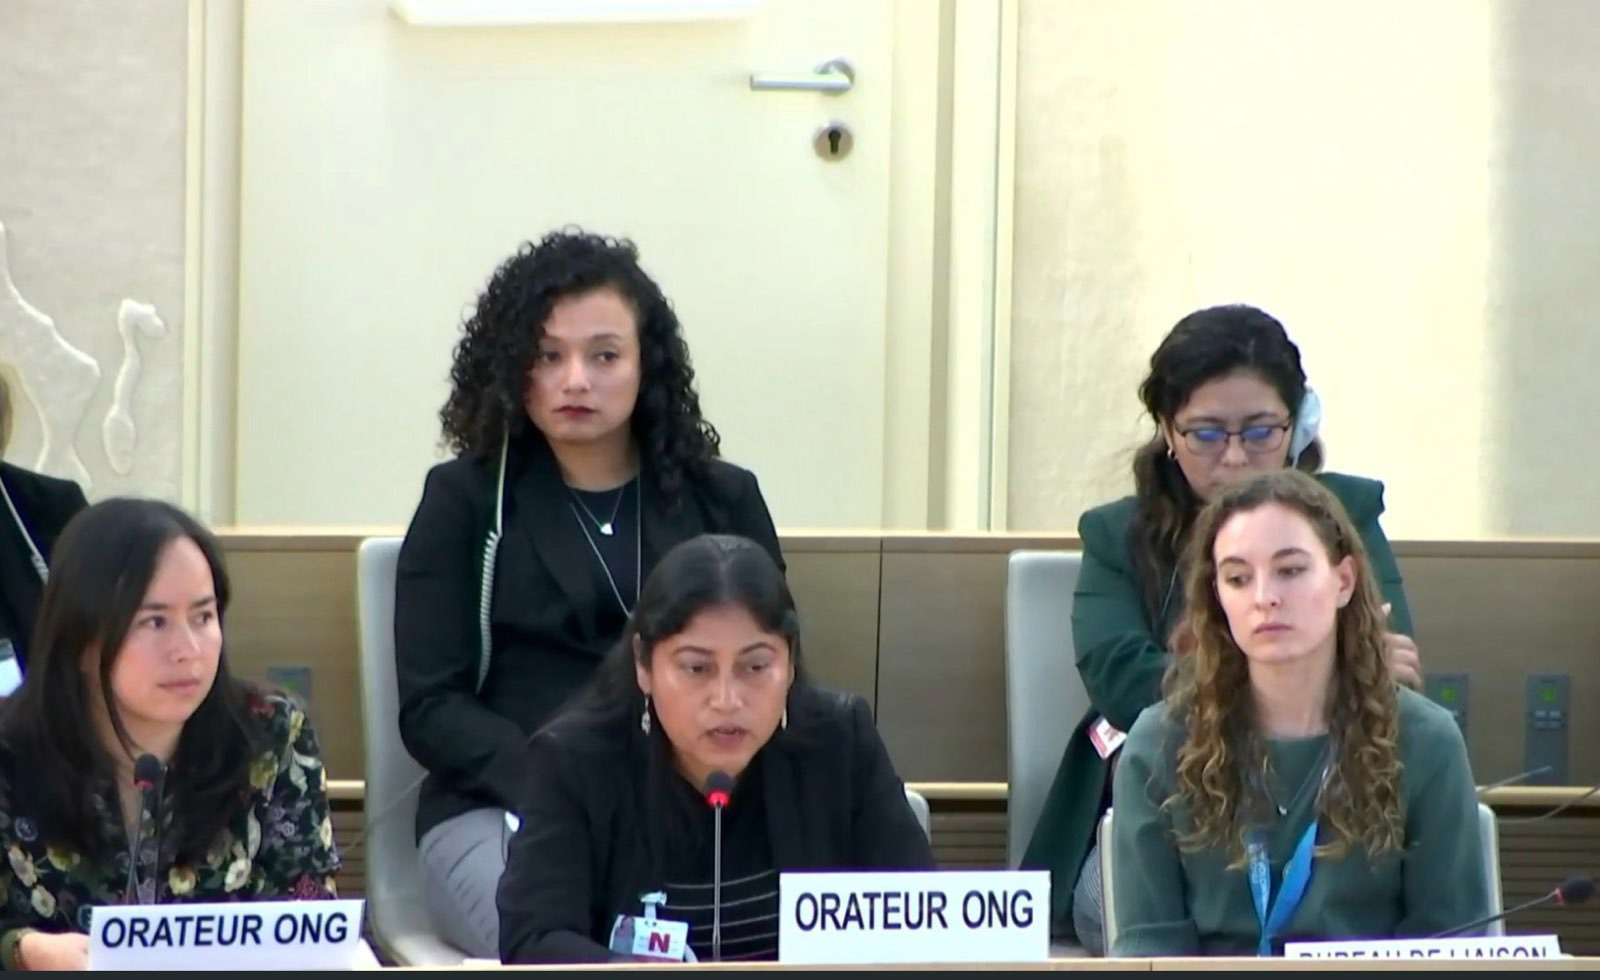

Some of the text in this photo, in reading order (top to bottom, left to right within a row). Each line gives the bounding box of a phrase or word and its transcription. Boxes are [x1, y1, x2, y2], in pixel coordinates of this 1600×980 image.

[796, 890, 1033, 931] ORATEUR ONG
[102, 912, 348, 948] ORATEUR ONG
[648, 931, 670, 953] N
